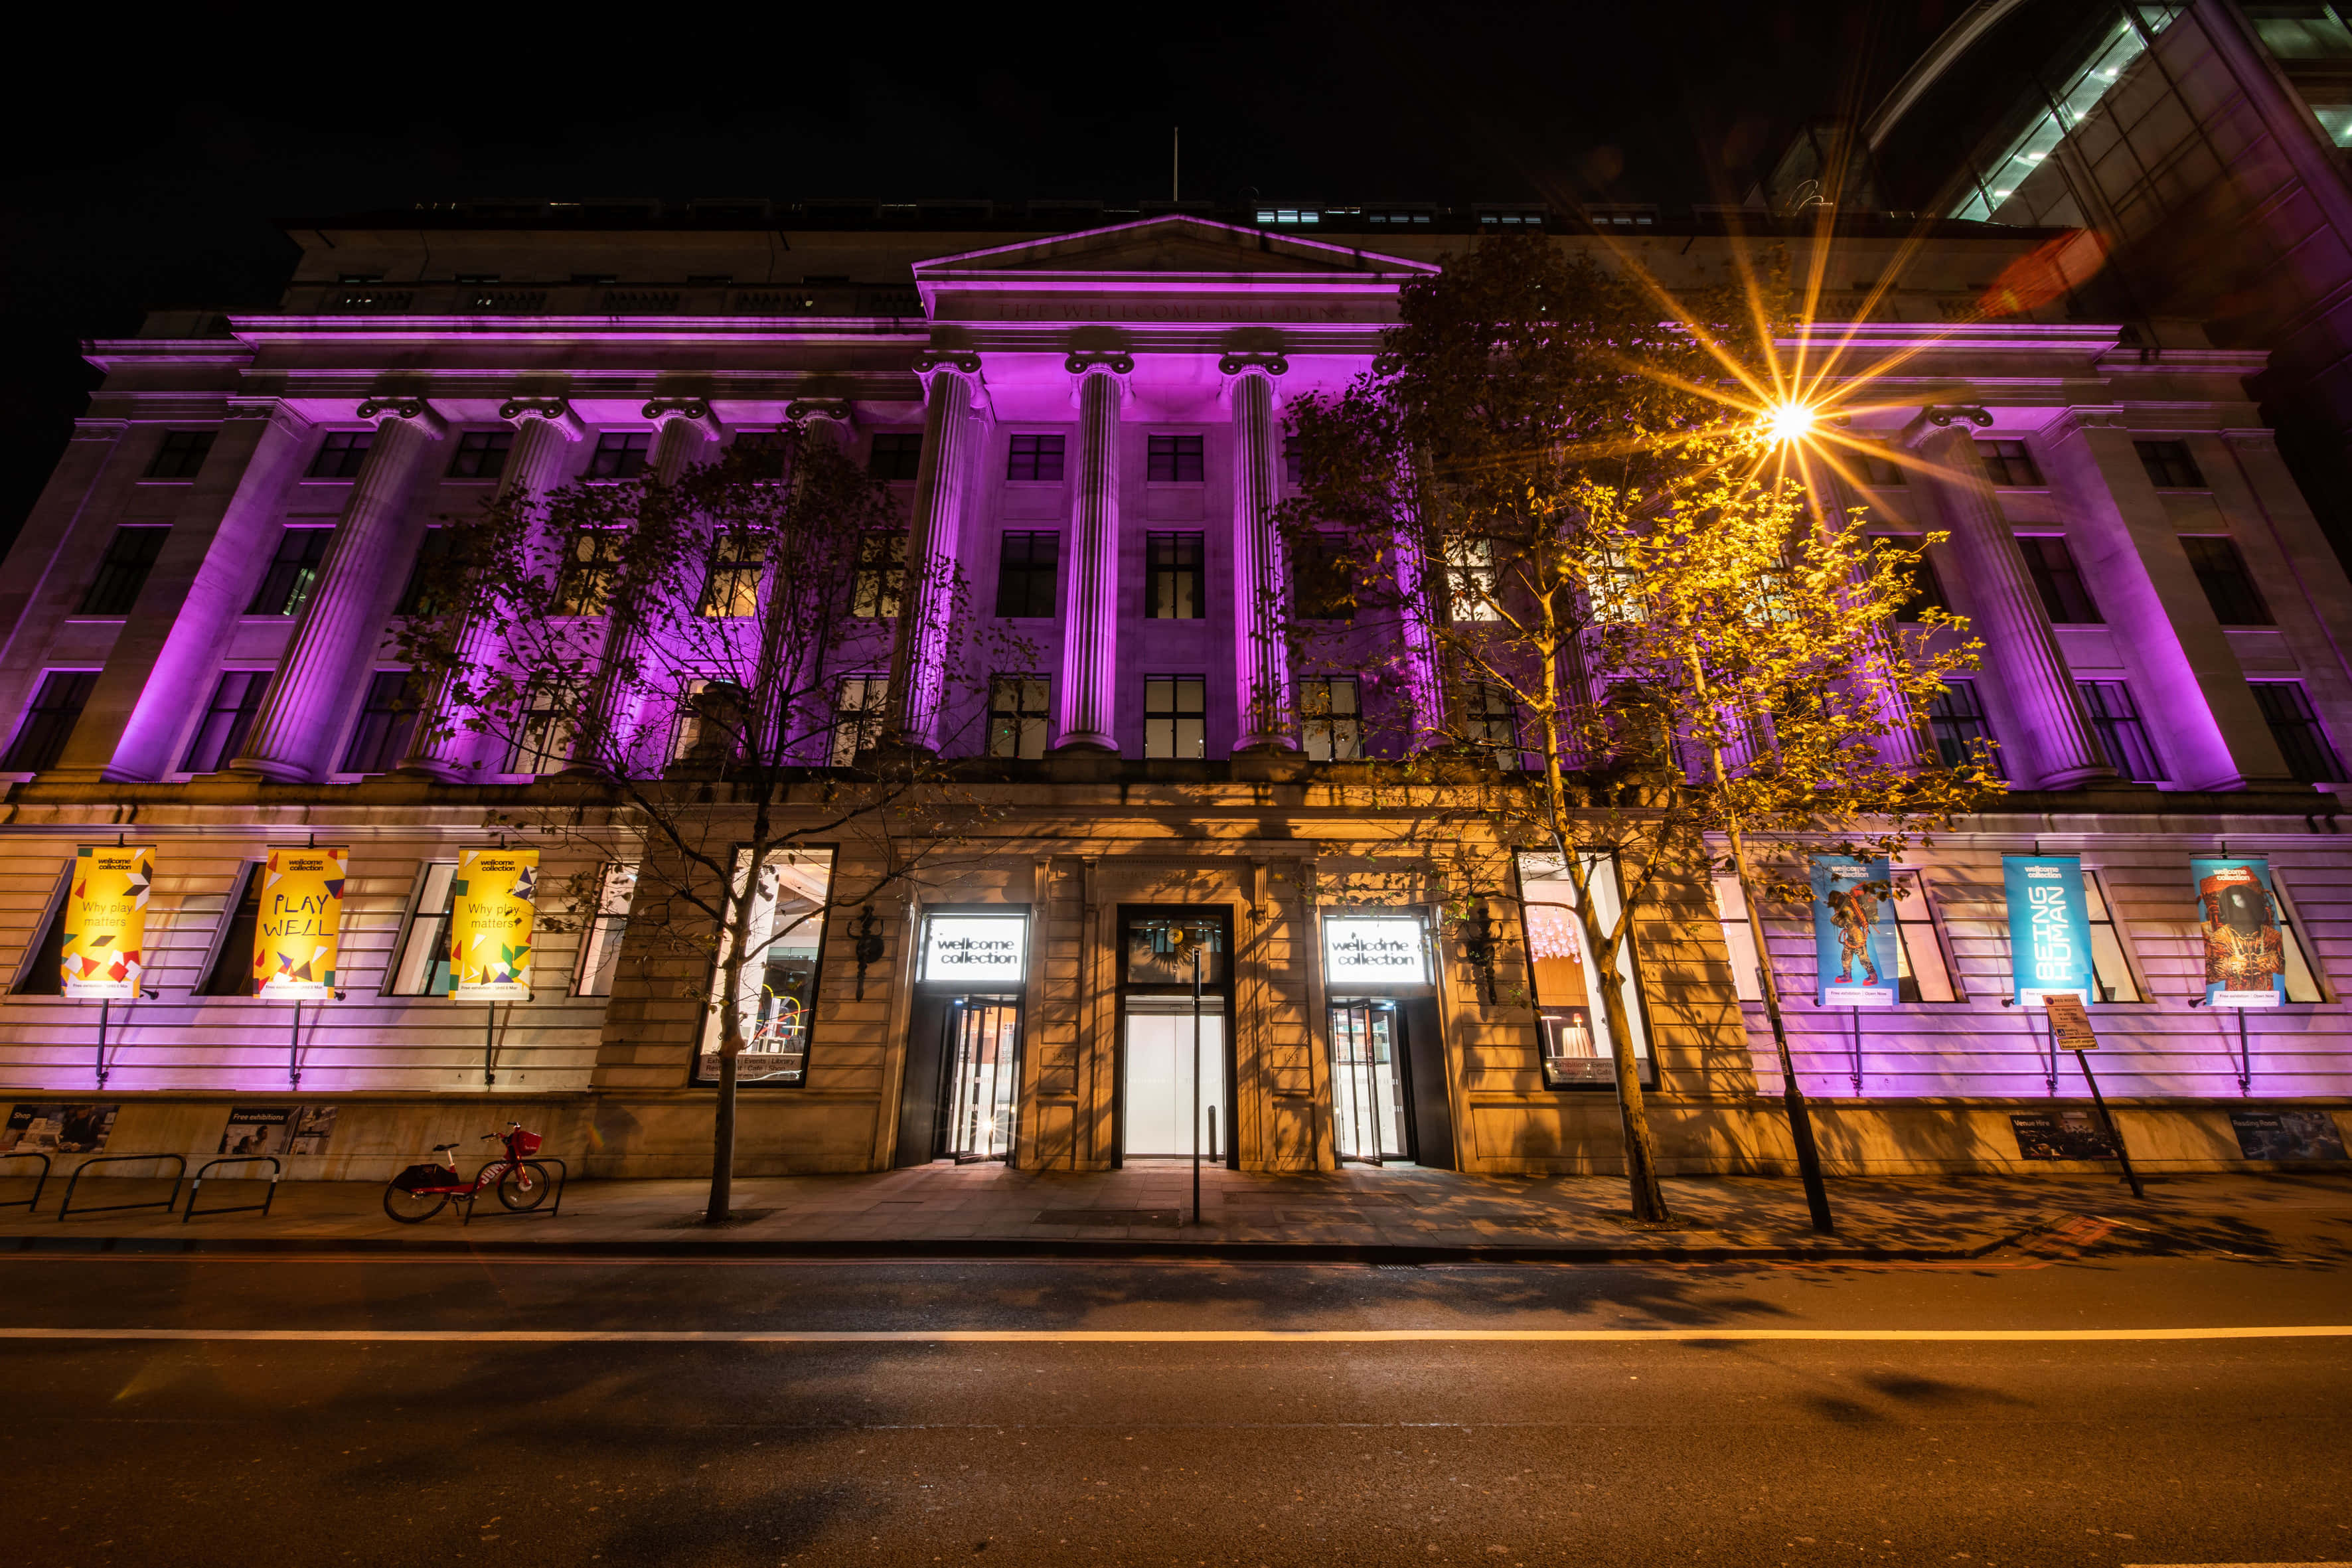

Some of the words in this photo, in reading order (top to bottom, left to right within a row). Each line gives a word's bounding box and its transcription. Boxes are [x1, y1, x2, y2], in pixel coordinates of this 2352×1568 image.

[998, 303, 1047, 318] THE
[1062, 303, 1206, 319] WELLCOME
[82, 902, 106, 915] Why
[110, 902, 133, 914] play
[274, 894, 329, 915] PLAY
[468, 903, 493, 916] Why
[84, 917, 126, 927] matters
[263, 919, 335, 937] WELL
[471, 919, 514, 928] matters
[2028, 886, 2054, 980] BEING
[2047, 886, 2073, 980] HUMAN
[937, 937, 1014, 950] wellcome
[1332, 938, 1409, 951] wellcome
[941, 951, 1018, 964] collection
[1338, 952, 1415, 965] collection
[249, 1113, 284, 1121] exhibitions
